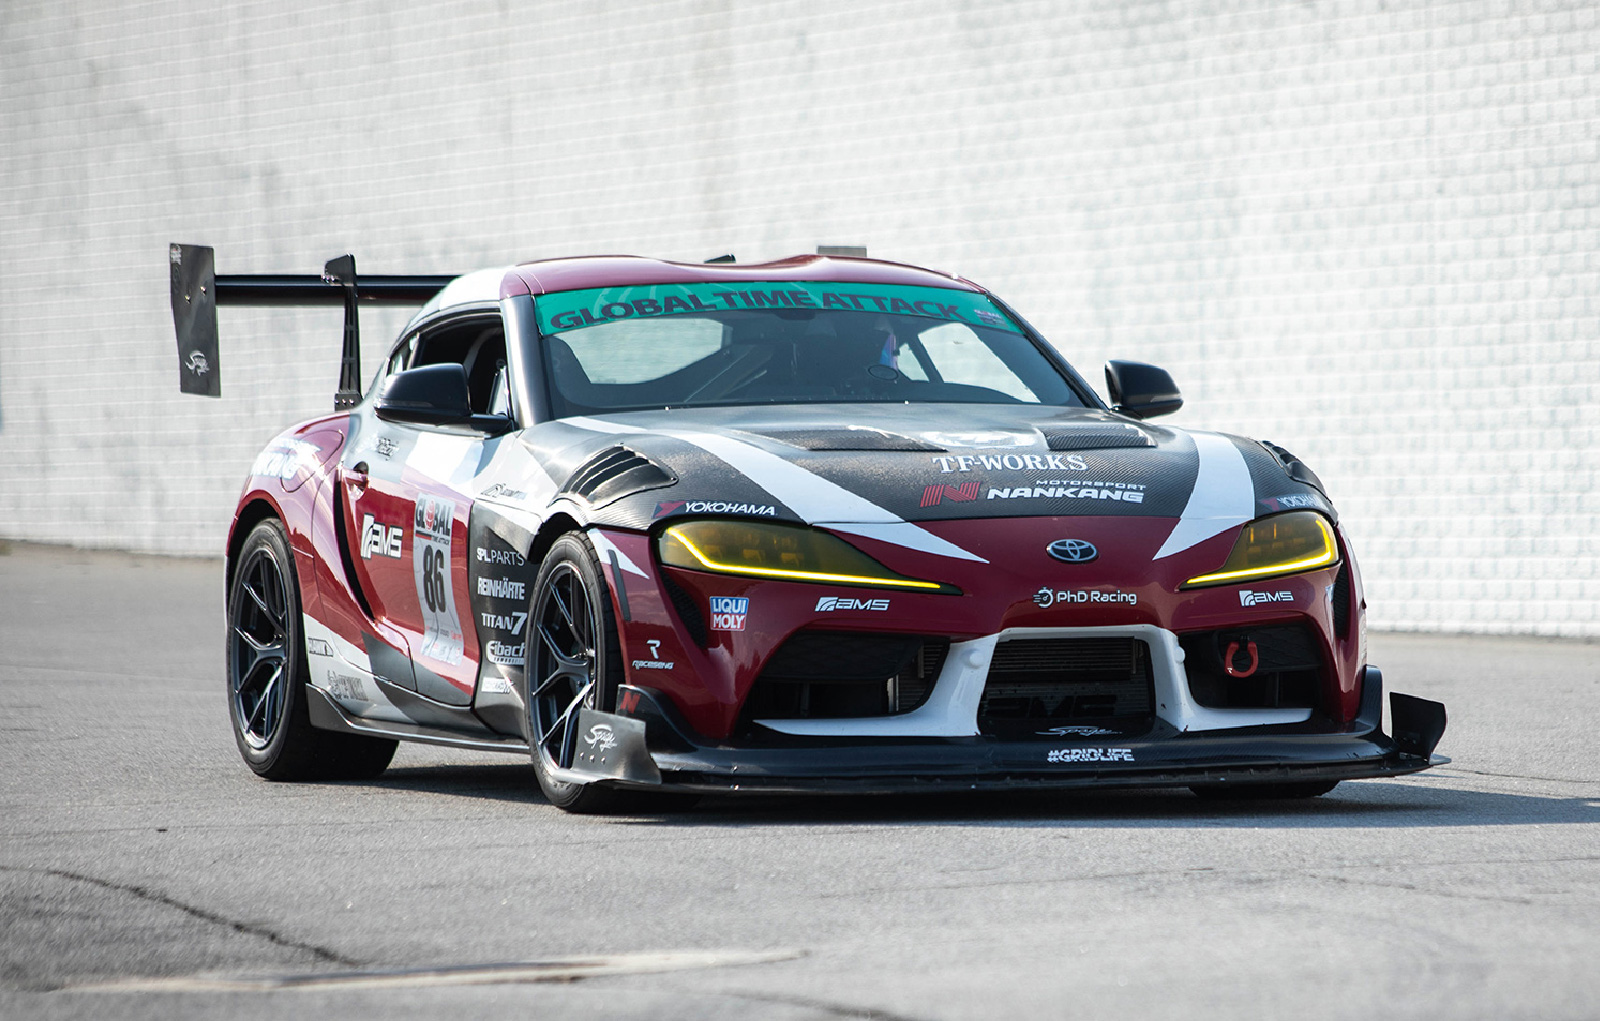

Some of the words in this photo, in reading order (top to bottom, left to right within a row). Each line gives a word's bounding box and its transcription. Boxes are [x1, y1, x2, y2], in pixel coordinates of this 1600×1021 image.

[551, 294, 717, 329] GLOBAL
[713, 290, 816, 308] TIME
[822, 292, 970, 321] ATTACK
[932, 454, 1089, 474] TF-WORKS
[1036, 479, 1147, 490] MOTORSPORT
[986, 487, 1145, 504] NANKANG
[685, 502, 776, 516] YOKOHAMA
[422, 544, 446, 613] 86
[477, 576, 526, 600] REINHÄRTE
[1056, 590, 1088, 603] PhD
[1090, 589, 1137, 605] Racing
[712, 598, 748, 613] LIQUI
[712, 614, 746, 629] MOLY
[1047, 748, 1135, 763] #GRIDLIFE
